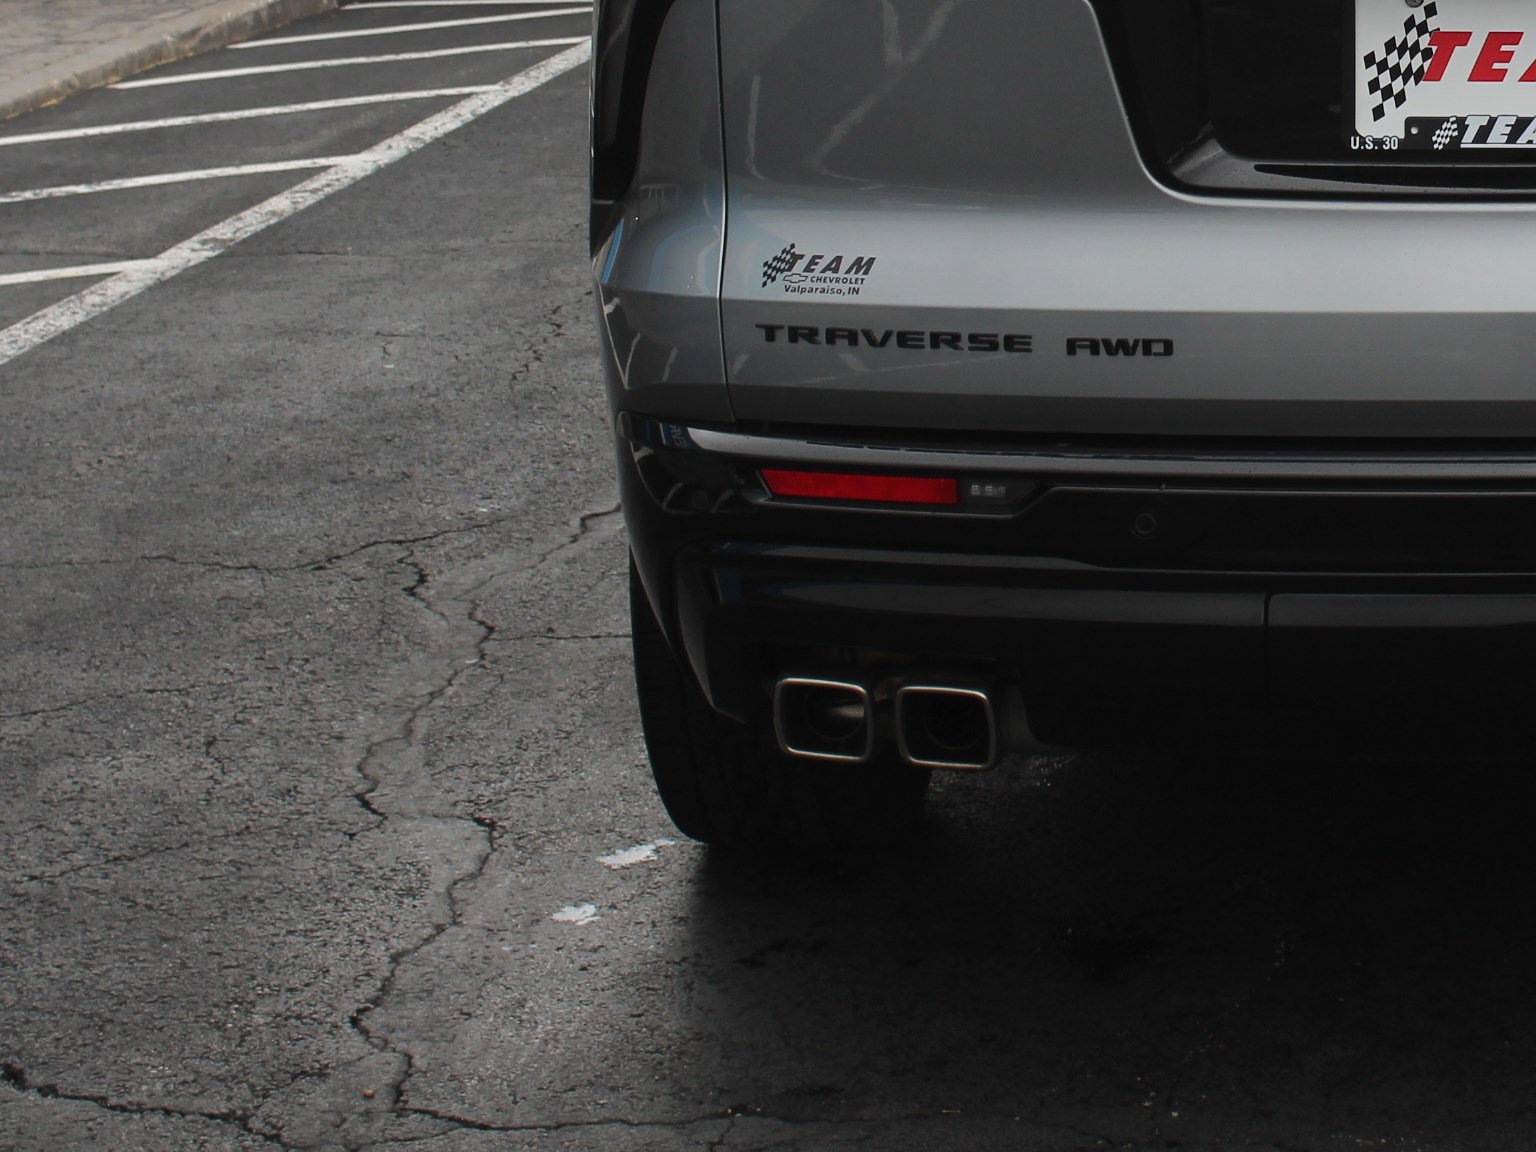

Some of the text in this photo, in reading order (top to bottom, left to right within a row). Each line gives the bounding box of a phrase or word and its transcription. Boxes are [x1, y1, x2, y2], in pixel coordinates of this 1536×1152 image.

[1350, 136, 1399, 150] U.S. 30
[782, 254, 877, 276] TEAM
[810, 275, 866, 285] CHEVROLET
[784, 285, 860, 296] Valparaiso, IN
[755, 322, 1174, 357] TRAVERSE AWD
